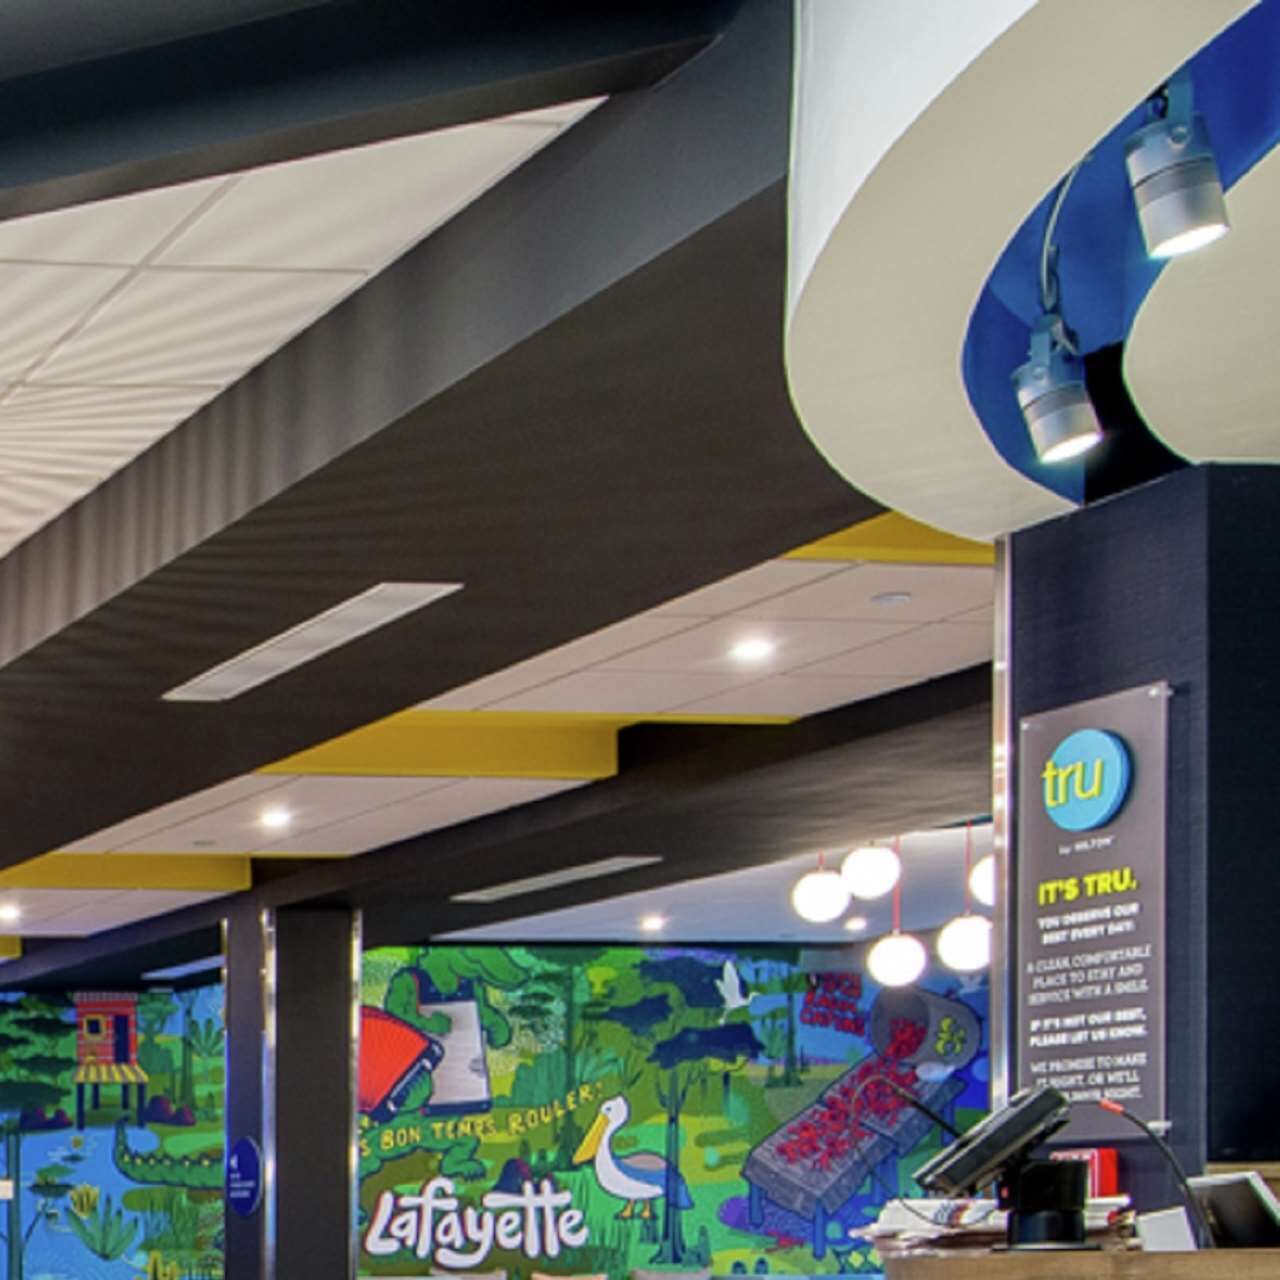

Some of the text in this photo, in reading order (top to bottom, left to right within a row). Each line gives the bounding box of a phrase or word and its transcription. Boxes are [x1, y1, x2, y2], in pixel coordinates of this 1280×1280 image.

[1041, 758, 1104, 807] tru
[1038, 867, 1137, 905] IT'S TRU.
[381, 1125, 421, 1151] BON
[431, 1118, 497, 1140] TEMPS
[365, 1177, 589, 1269] Lafayette
